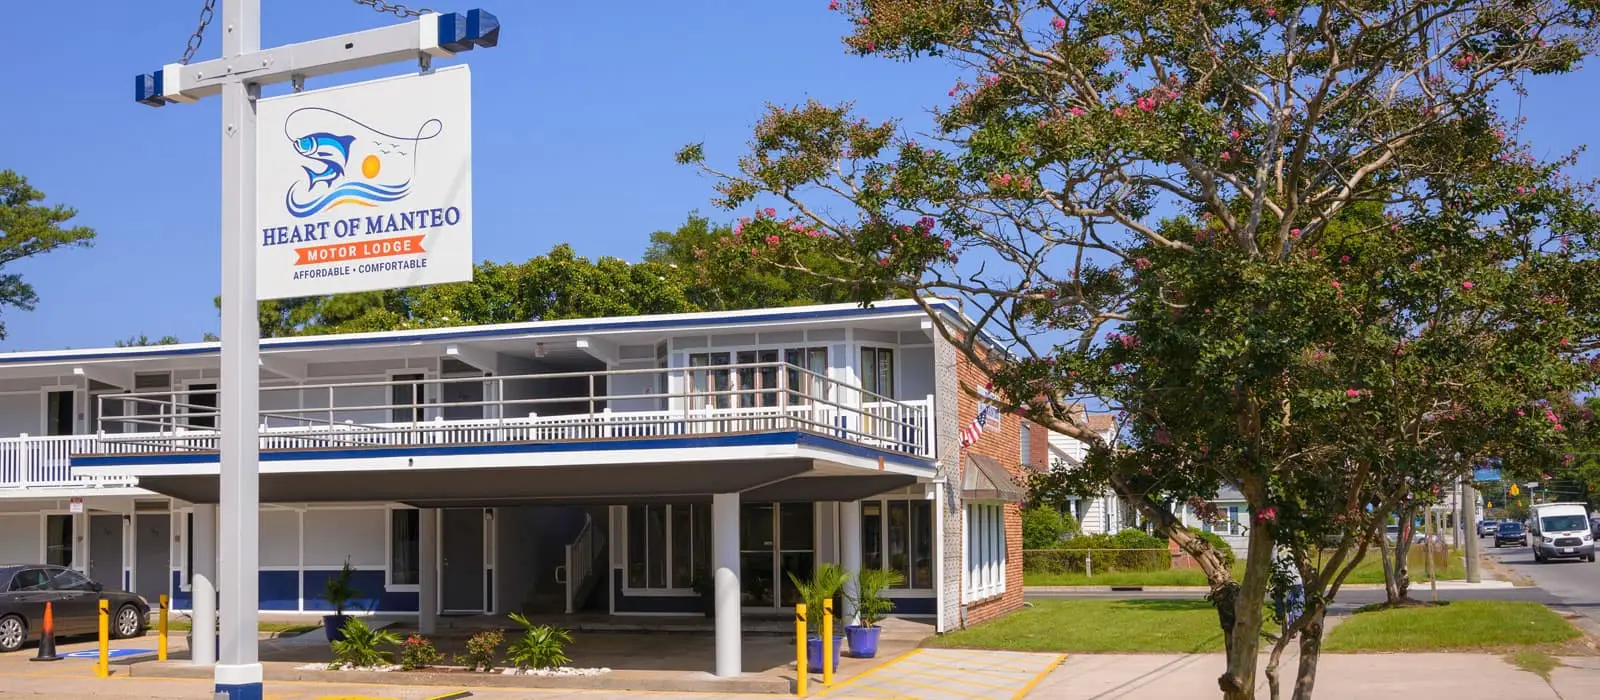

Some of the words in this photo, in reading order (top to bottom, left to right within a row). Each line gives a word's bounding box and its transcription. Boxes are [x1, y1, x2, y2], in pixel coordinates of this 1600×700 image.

[262, 222, 329, 246] HEART
[333, 217, 360, 238] OF
[365, 206, 460, 235] MANTEO
[307, 246, 357, 261] MOTOR
[364, 239, 412, 256] LODGE
[293, 266, 350, 280] AFFORDABLE
[358, 258, 427, 274] COMFORTABLE
